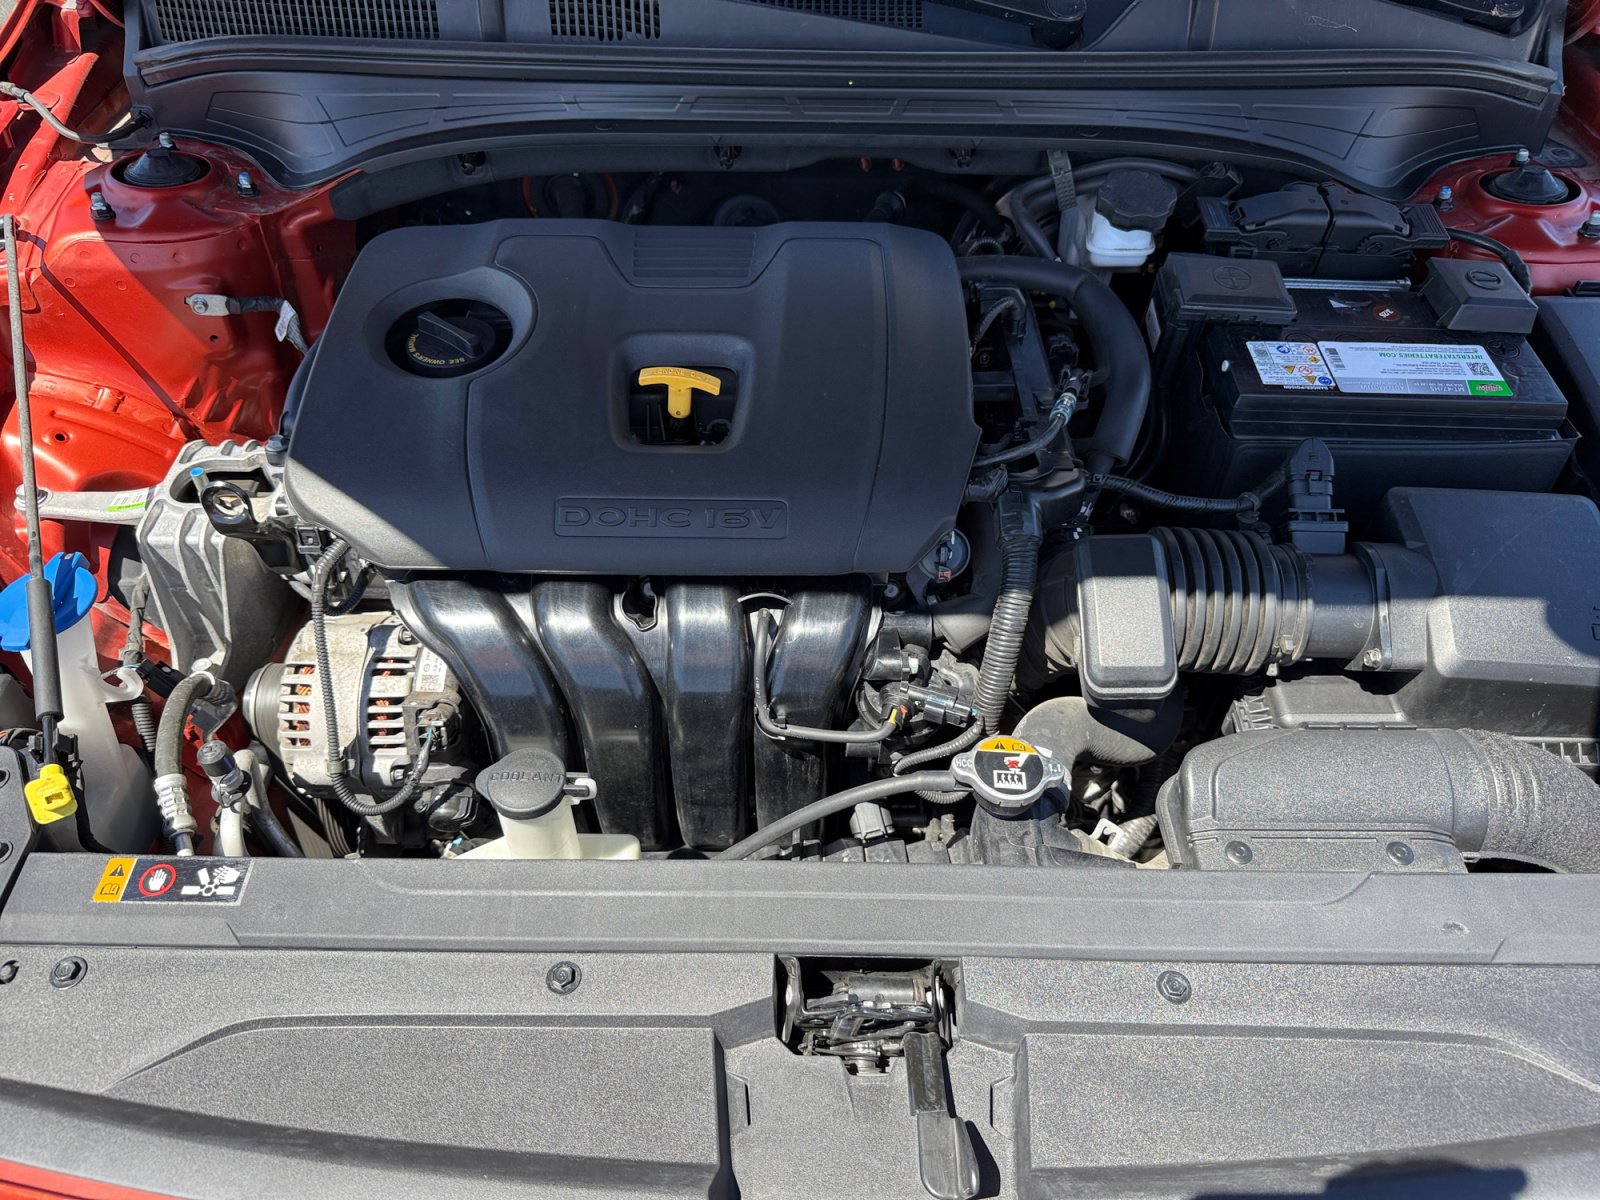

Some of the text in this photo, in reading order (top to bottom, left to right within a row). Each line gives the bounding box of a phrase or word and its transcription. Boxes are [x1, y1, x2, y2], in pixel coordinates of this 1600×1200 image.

[448, 357, 466, 365] SEE
[1378, 352, 1484, 360] INTERSTATEBATTERIES.COM
[559, 506, 784, 529] DOHC 16V
[954, 758, 973, 768] HCC
[1047, 763, 1062, 773] 1.1
[490, 771, 565, 783] COOLANT
